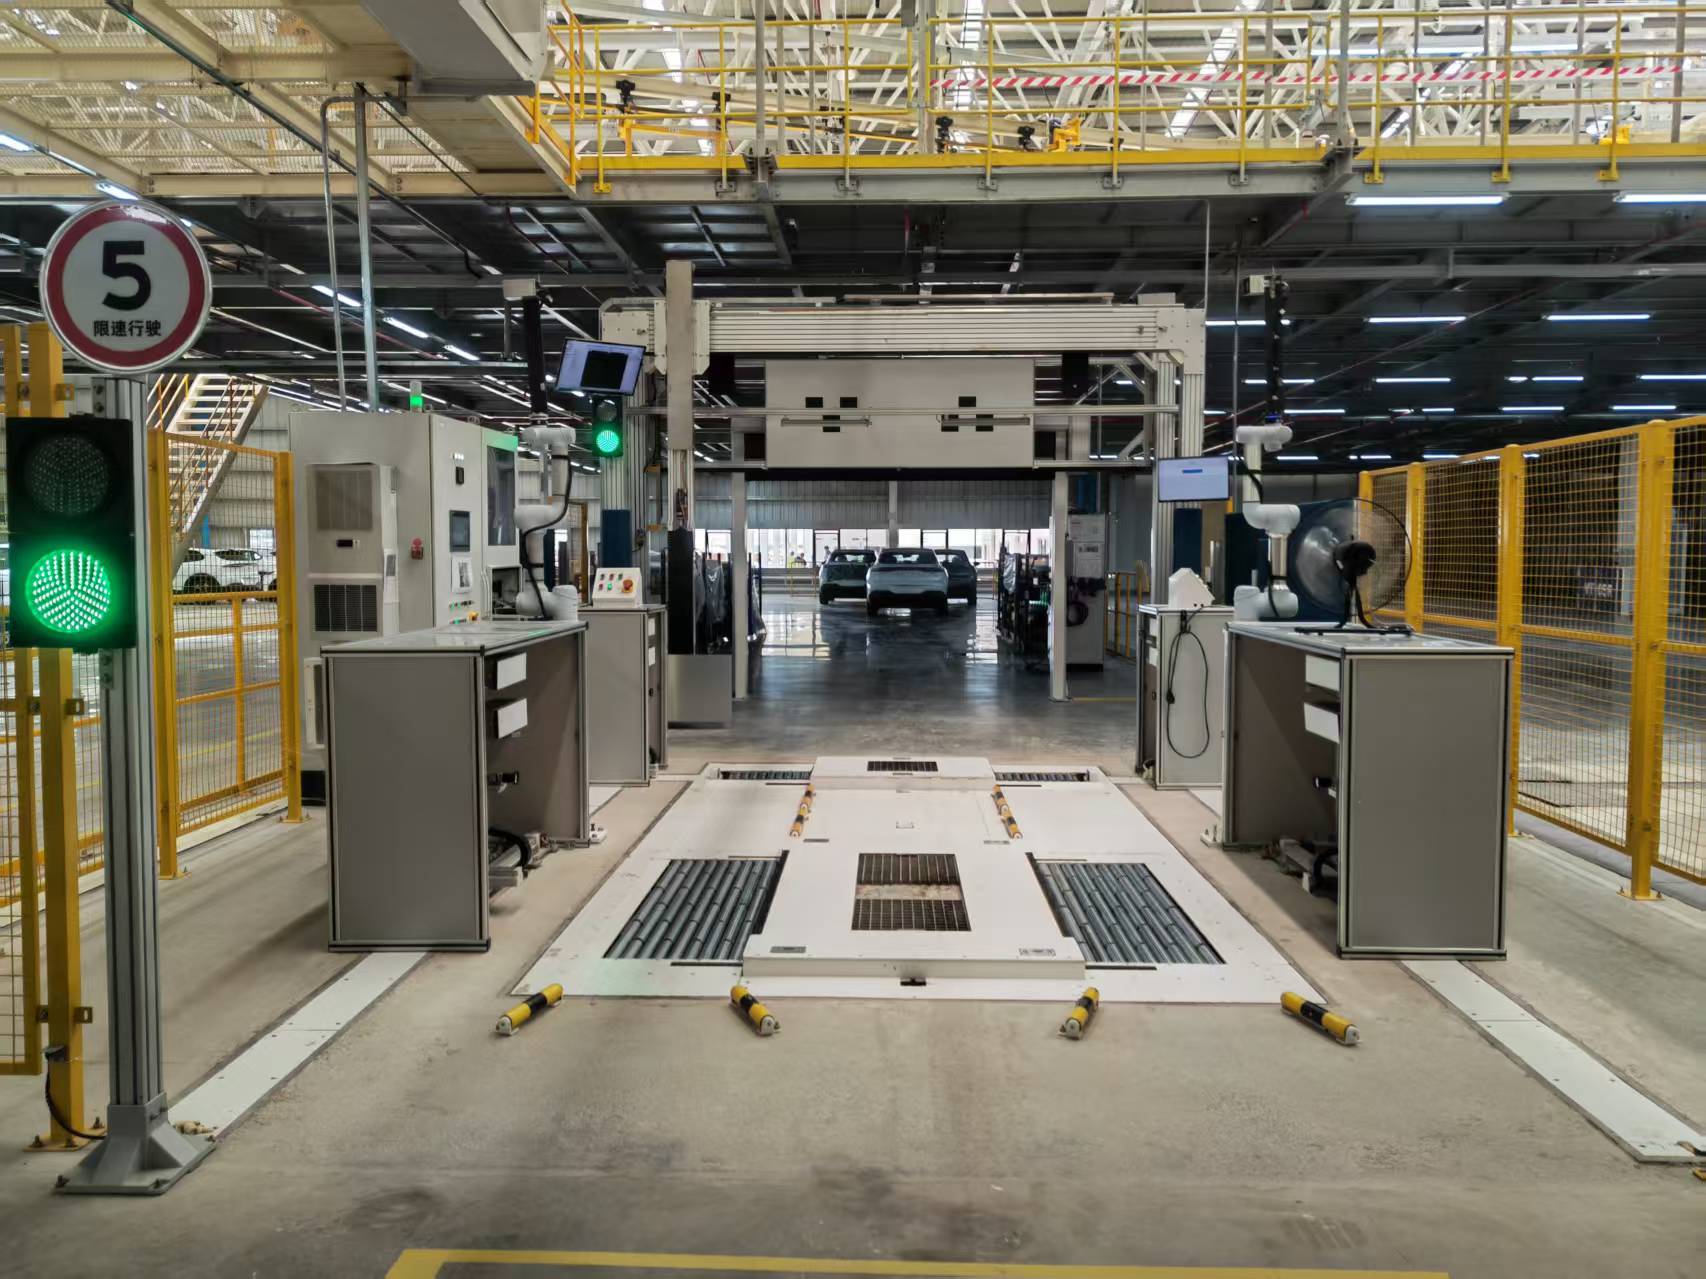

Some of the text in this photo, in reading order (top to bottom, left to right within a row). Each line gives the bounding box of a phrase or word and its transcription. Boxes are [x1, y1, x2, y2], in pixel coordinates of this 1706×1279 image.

[102, 240, 151, 311] 5
[93, 320, 162, 337] 限速行驶
